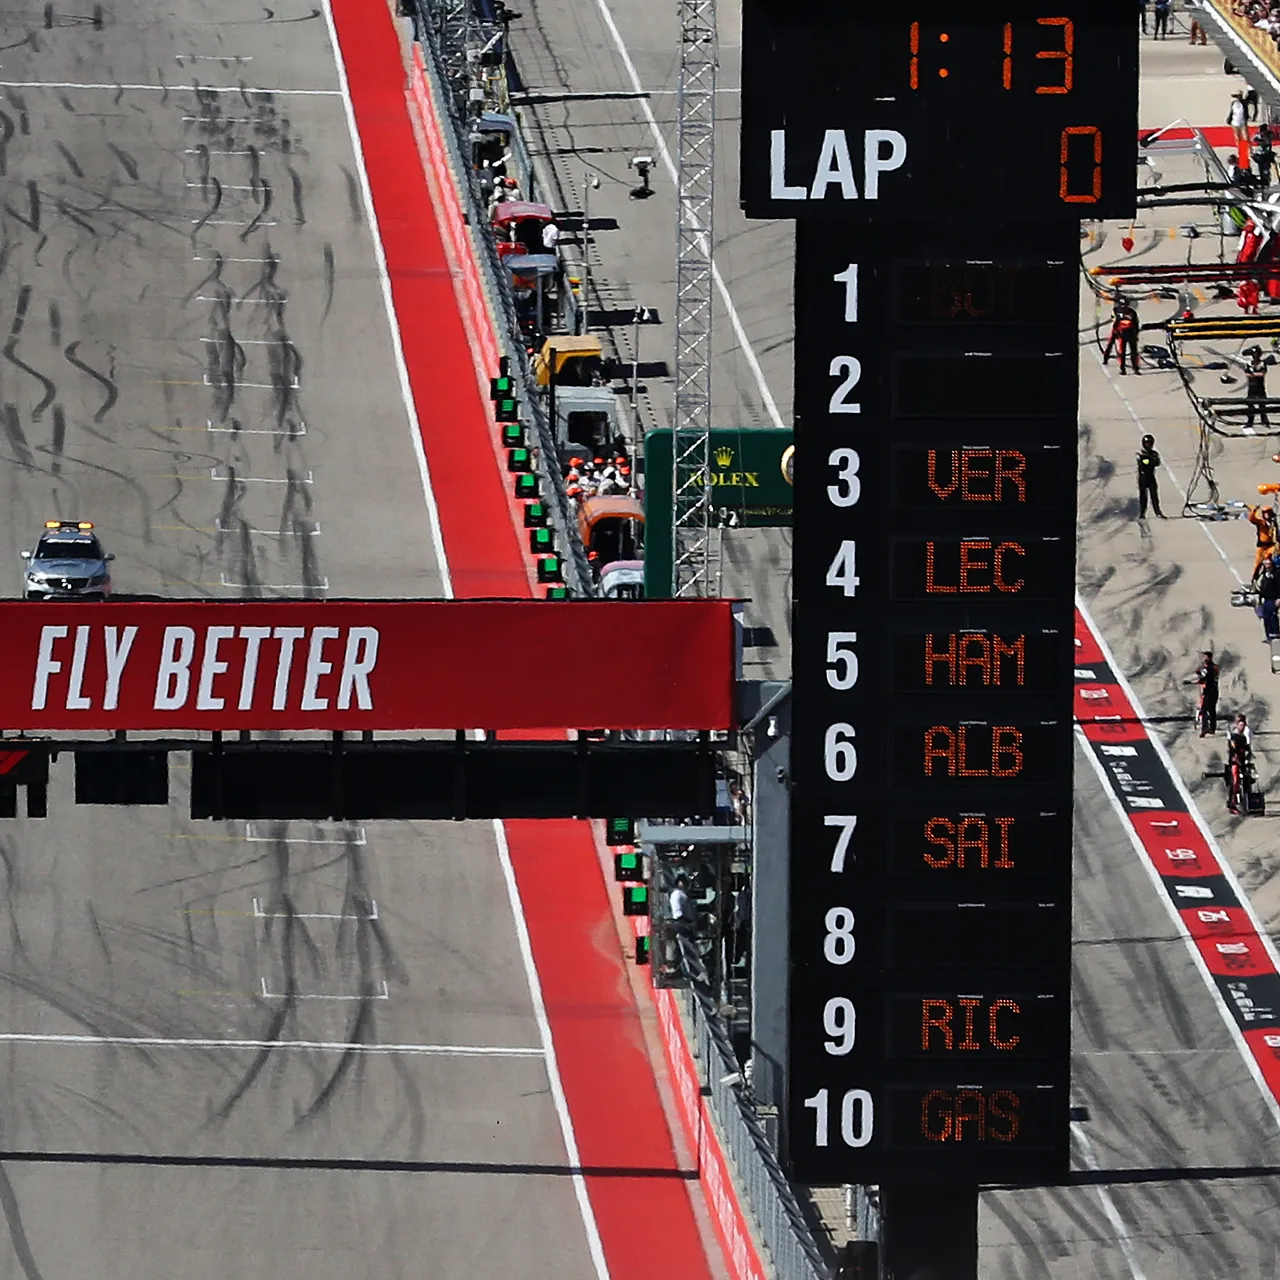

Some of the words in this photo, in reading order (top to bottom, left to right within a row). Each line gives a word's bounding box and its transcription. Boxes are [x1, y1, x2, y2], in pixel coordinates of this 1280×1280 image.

[910, 17, 1074, 94] 1:13
[771, 129, 907, 200] LAP
[1060, 126, 1102, 203] 0
[834, 264, 858, 322] 1
[829, 356, 861, 414] 2
[828, 448, 860, 507] 3
[927, 449, 1027, 502] VER
[826, 541, 859, 597] 4
[926, 542, 1025, 593] LEC
[32, 625, 138, 710] FLY
[154, 625, 379, 711] BETTER
[826, 632, 858, 690] 5
[925, 634, 1025, 685] HAM
[825, 723, 857, 781] 6
[924, 727, 1023, 778] ALB
[824, 816, 857, 873] 7
[923, 817, 1015, 869] SAI
[824, 907, 856, 965] 8
[824, 997, 856, 1055] 9
[922, 1000, 1020, 1050] RIC
[805, 1089, 874, 1148] 10
[922, 1090, 1019, 1141] GAS
